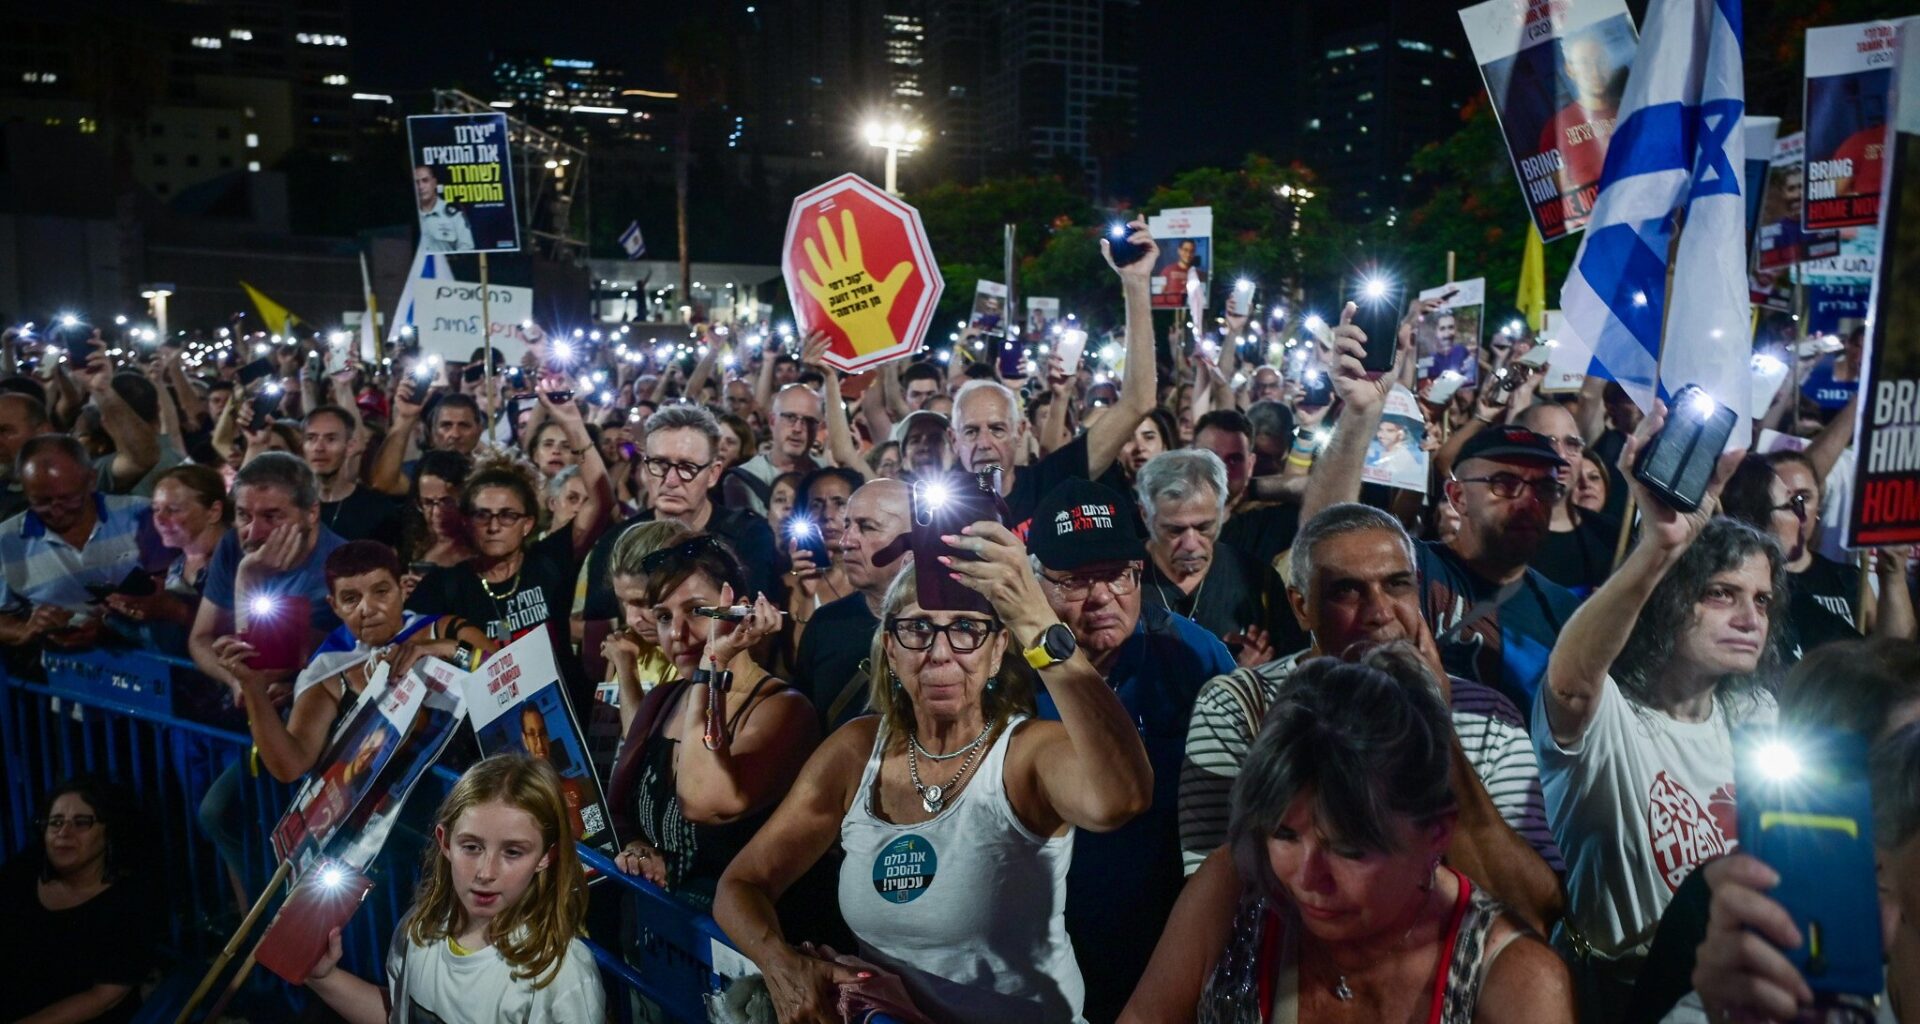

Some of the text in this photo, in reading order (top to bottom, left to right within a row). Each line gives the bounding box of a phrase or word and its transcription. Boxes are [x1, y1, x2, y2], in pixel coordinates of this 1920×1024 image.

[423, 145, 500, 166] את התנאים
[1520, 149, 1564, 181] BRING
[447, 163, 501, 183] לשחרור
[1808, 158, 1853, 182] BRING
[1529, 177, 1558, 204] HIM
[1808, 181, 1837, 201] HIM
[1536, 186, 1599, 229] HOME NO
[1808, 198, 1849, 220] HOME
[436, 286, 513, 304] החטופים
[828, 279, 845, 291] דמי
[851, 283, 874, 299] אחיך
[869, 295, 882, 308] מן
[432, 315, 481, 333] לחיות
[1874, 379, 1920, 426] BRI
[1868, 428, 1920, 474] HIM
[1862, 481, 1920, 524] HOM
[1056, 517, 1113, 536] הדור הלא נכון
[520, 602, 551, 627] אותם
[884, 851, 926, 866] את כולם
[886, 864, 921, 877] בהסכם
[883, 876, 924, 892] עכשיו!
